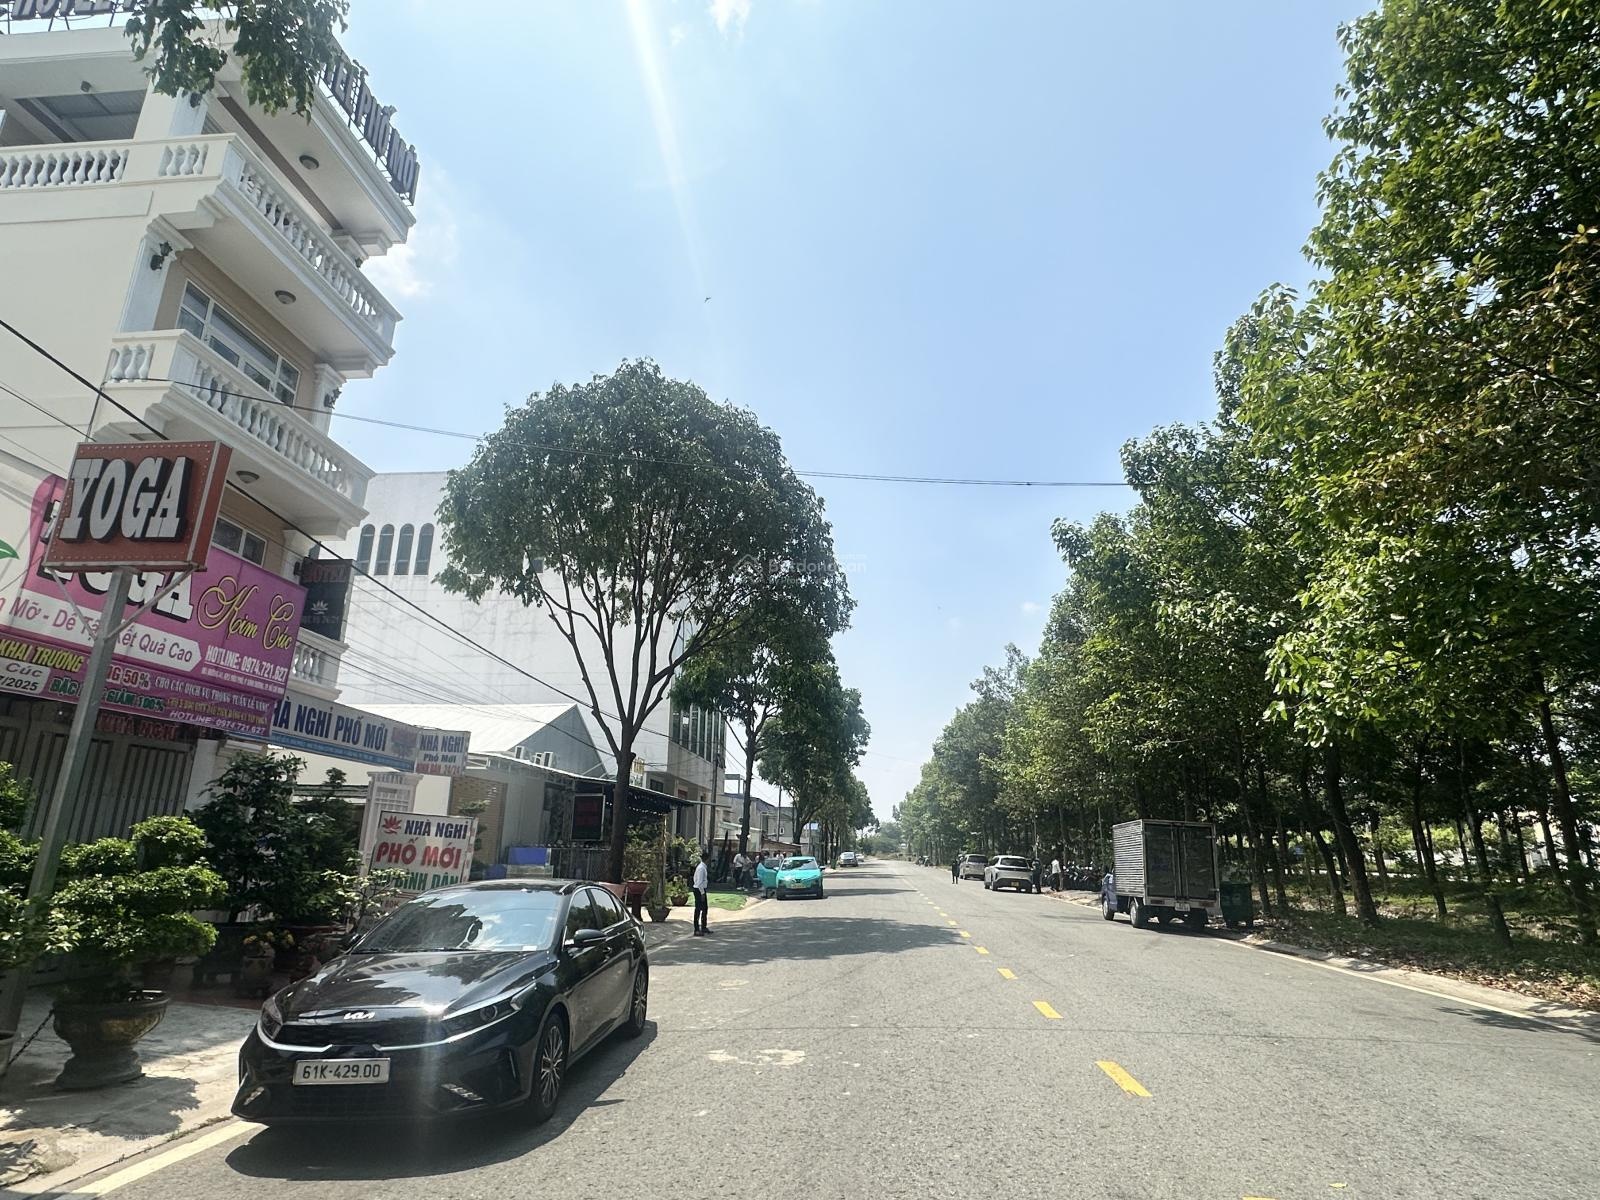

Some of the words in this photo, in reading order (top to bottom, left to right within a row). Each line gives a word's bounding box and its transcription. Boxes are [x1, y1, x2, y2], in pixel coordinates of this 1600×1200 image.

[59, 457, 193, 542] YOGA
[198, 575, 259, 639] Kim
[263, 594, 295, 650] Cúc
[9, 597, 42, 620] Mỡ
[139, 634, 166, 656] Quả
[169, 643, 193, 662] Cao
[6, 662, 43, 677] Cúc
[123, 669, 149, 688] 50%
[205, 645, 241, 669] HOTLINE:
[241, 656, 288, 682] 0974.721.627
[215, 719, 266, 735] 0974.721.627
[294, 704, 334, 738] NGHỈ
[334, 716, 364, 745] PHỐ
[404, 819, 431, 837] NHÀ
[435, 821, 468, 839] NGHỈ
[376, 837, 417, 865] PHỐ
[421, 842, 462, 869] MỚI
[302, 1064, 381, 1079] 61K-429.00
